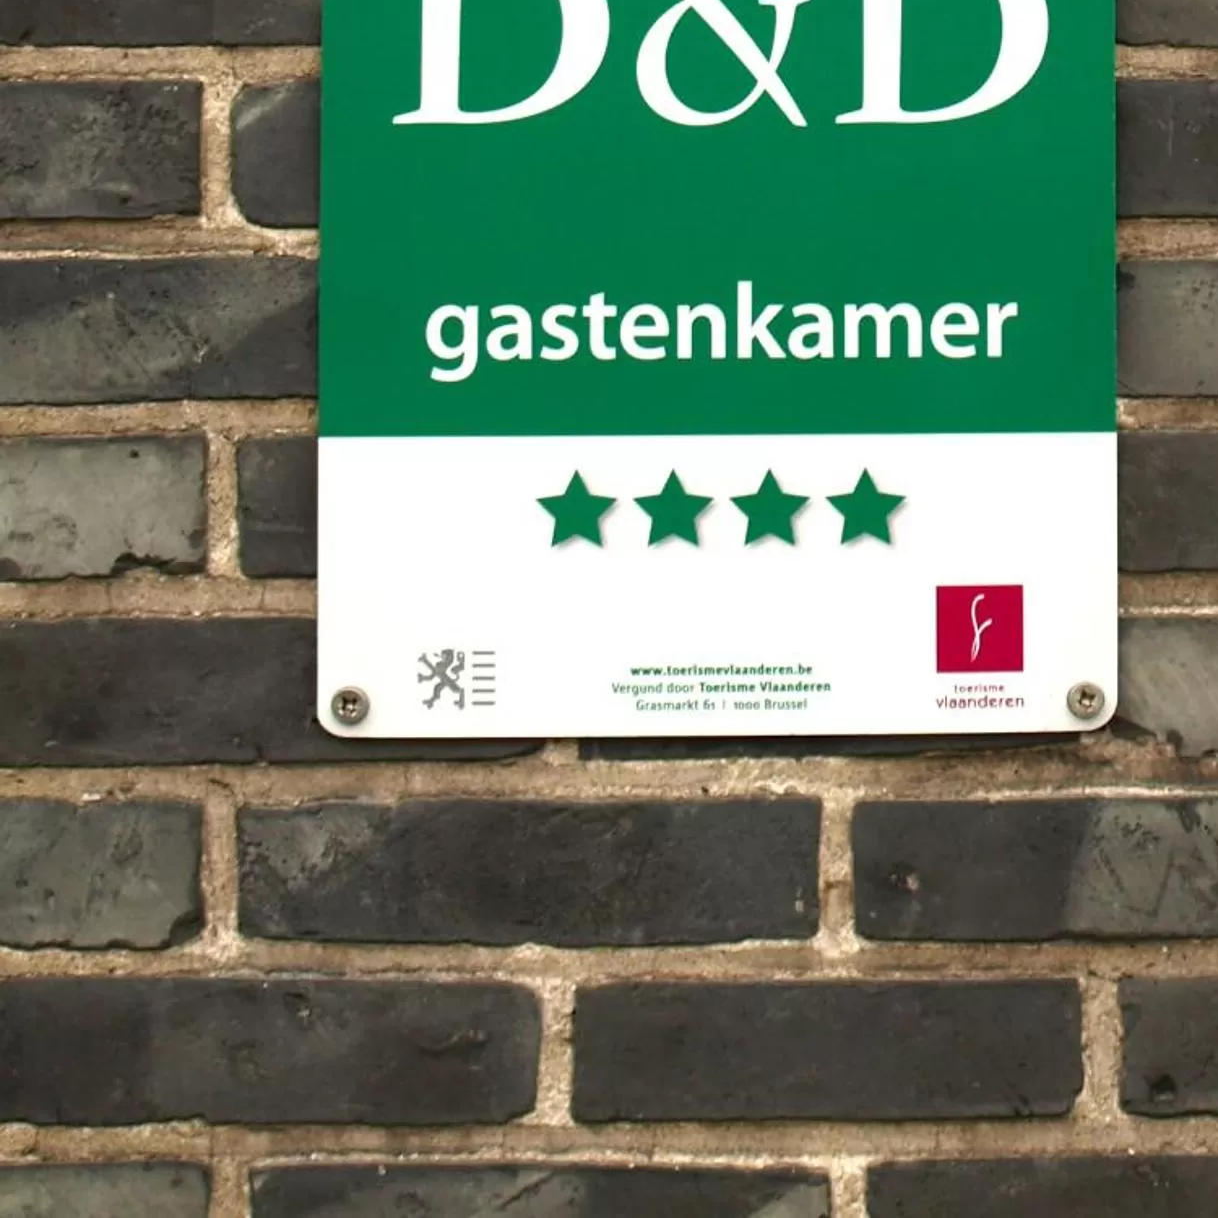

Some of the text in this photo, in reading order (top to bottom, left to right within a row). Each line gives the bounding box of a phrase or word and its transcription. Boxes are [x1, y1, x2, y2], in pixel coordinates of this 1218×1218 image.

[425, 280, 1018, 383] gastenkamer
[629, 663, 813, 677] www.toerismevlaanderen.be
[611, 680, 832, 697] Vergund door Toerisme Vlaanderen
[953, 684, 1005, 694] toerisme
[634, 699, 699, 711] Grasmarkt
[733, 701, 761, 710] 1000
[764, 698, 808, 711] Brussel
[935, 694, 1025, 709] vlaanderen
